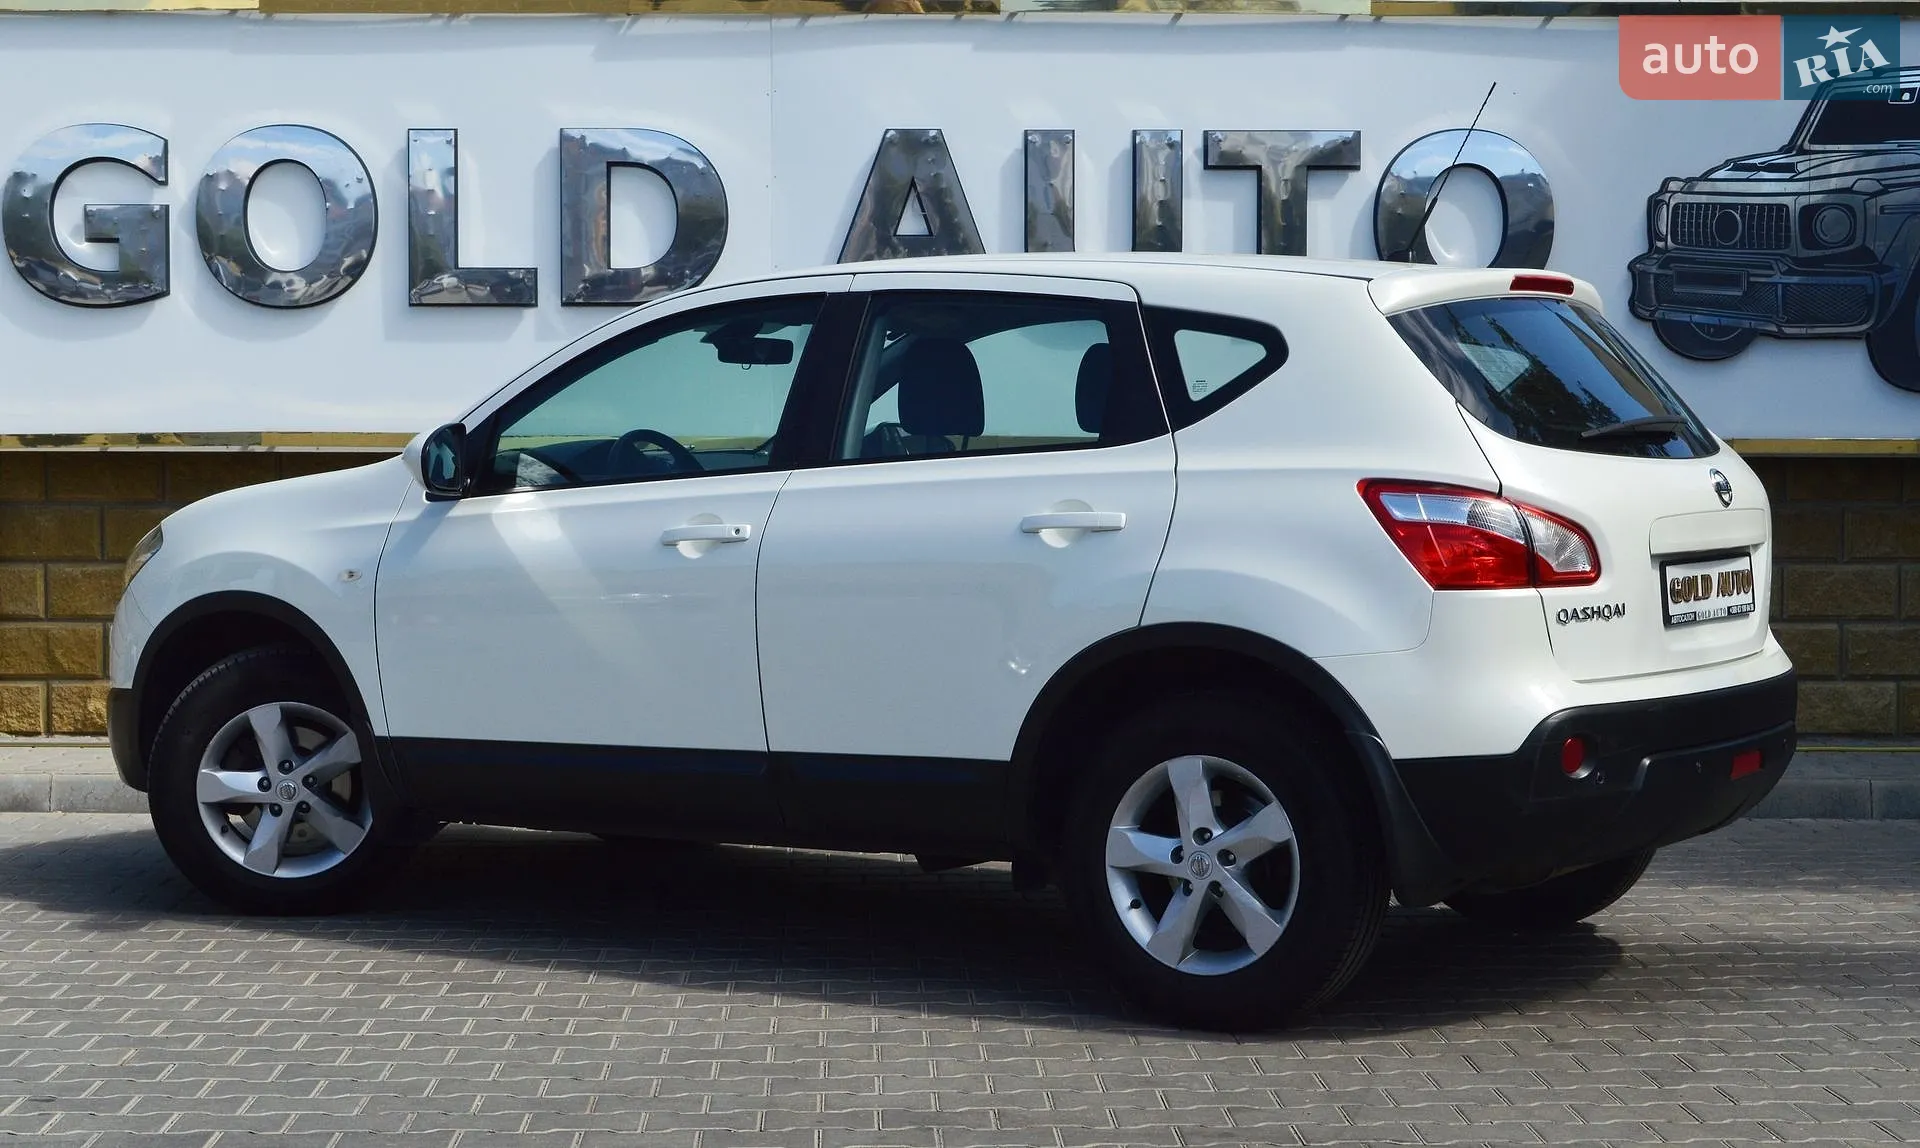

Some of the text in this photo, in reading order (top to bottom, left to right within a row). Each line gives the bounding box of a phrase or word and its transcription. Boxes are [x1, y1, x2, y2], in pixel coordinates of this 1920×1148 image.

[3, 122, 1554, 308] GOLD AUTO
[1670, 569, 1752, 604] GOLD AUTO
[1557, 603, 1625, 625] QASHQAI
